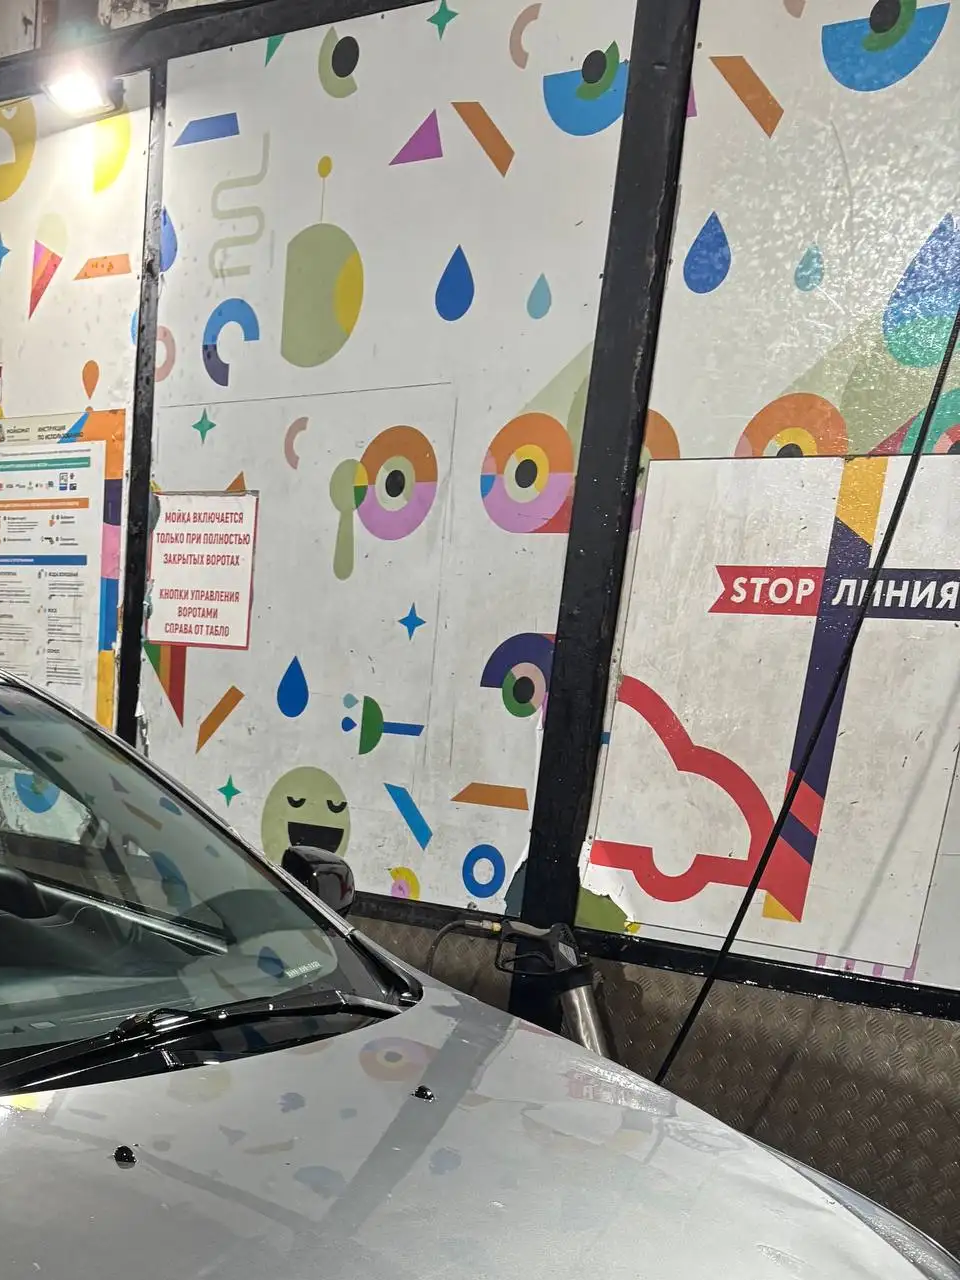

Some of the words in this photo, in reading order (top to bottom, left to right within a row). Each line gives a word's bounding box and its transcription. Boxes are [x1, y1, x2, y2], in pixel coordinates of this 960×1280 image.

[164, 510, 191, 524] МОЙКА
[192, 511, 244, 524] ВКЛЮЧАЕТСЯ
[156, 532, 185, 544] ТОЛЬКО
[186, 533, 202, 545] ПРИ
[203, 533, 251, 545] ПОЛНОСТЬЮ
[163, 553, 205, 566] ЗАКРЫТЫХ
[206, 554, 240, 566] ВОРОТАХ
[159, 588, 189, 601] КНОПКИ
[190, 589, 240, 602] УПРАВЛЕНИЯ
[729, 576, 816, 605] STOP
[831, 578, 960, 610] ЛИНИЯ
[177, 606, 218, 619] ВОРОТАМИ
[164, 623, 193, 635] СПРАВА
[194, 624, 204, 636] ОТ
[205, 625, 230, 637] ТАБЛО
